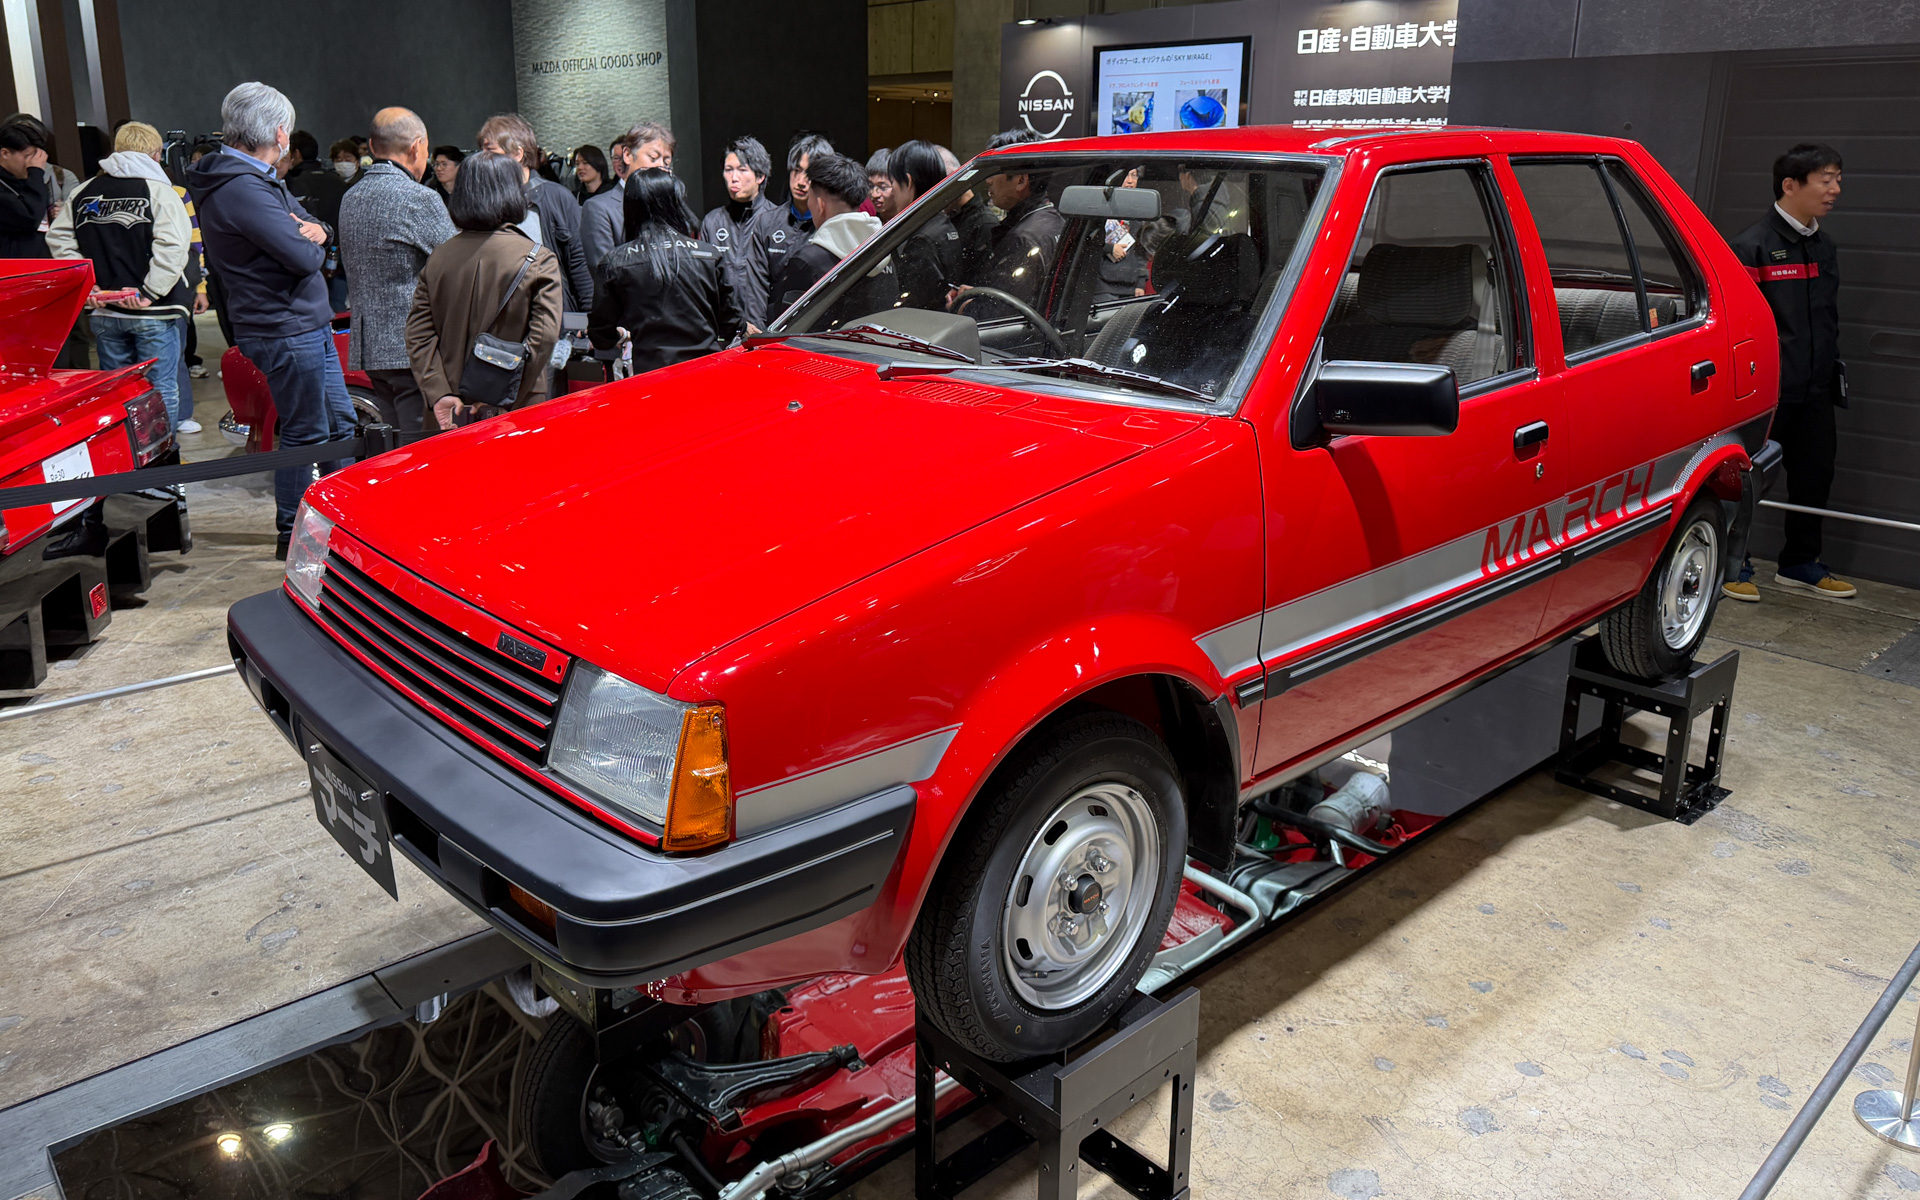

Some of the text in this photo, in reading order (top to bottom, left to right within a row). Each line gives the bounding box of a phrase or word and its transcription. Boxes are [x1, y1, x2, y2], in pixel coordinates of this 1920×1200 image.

[532, 51, 662, 75] MAZDA OFFICIAL GOODS SHOP
[1018, 98, 1074, 112] NISSAN
[1480, 460, 1657, 576] MARCH
[313, 765, 383, 865] マーチ
[324, 764, 358, 806] NISSAN
[980, 936, 1002, 1018] YOKOHAMA
